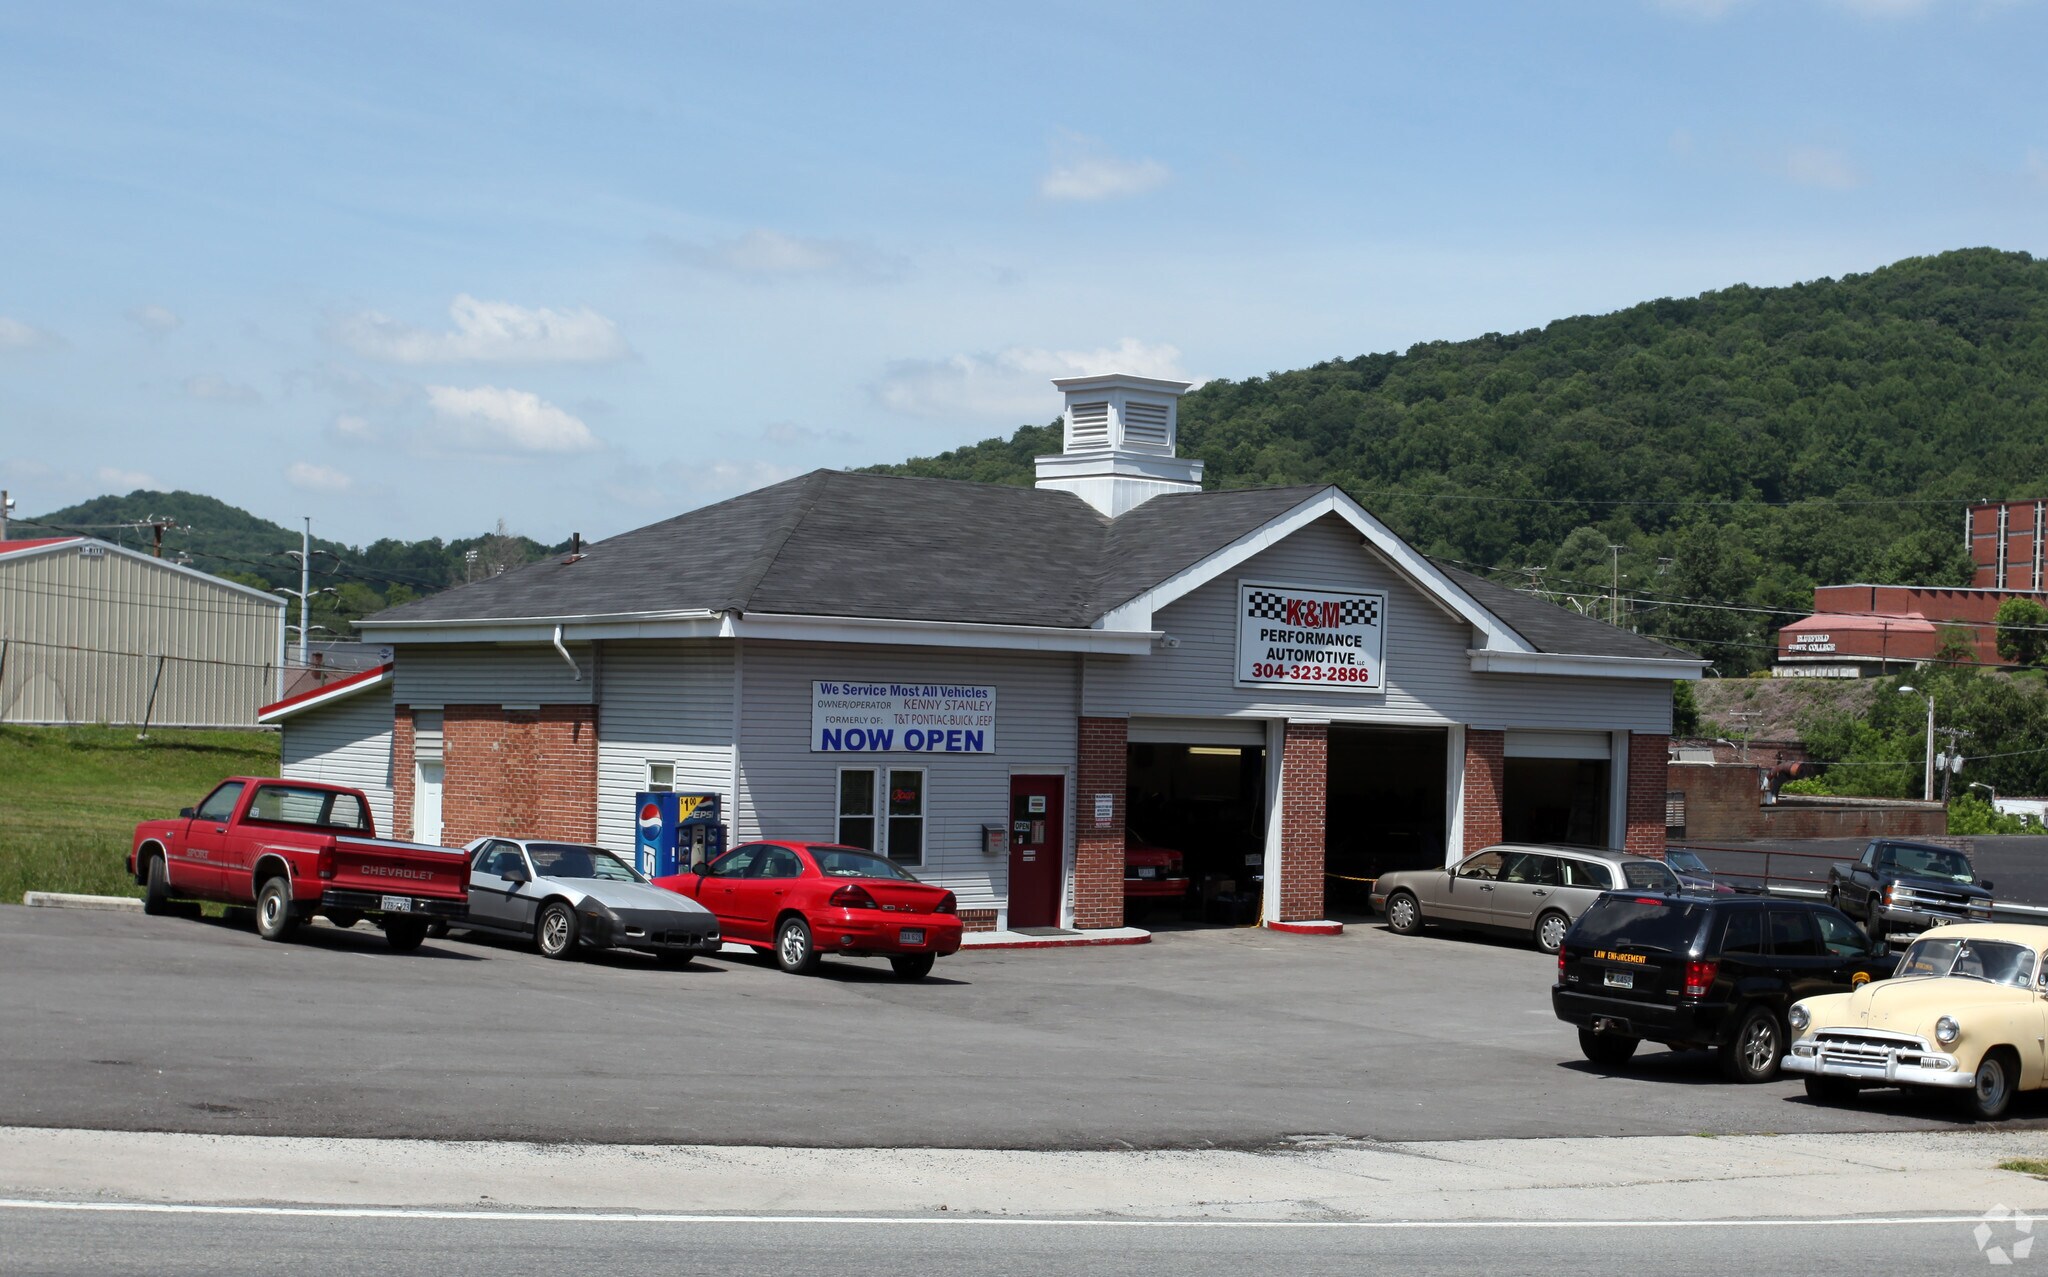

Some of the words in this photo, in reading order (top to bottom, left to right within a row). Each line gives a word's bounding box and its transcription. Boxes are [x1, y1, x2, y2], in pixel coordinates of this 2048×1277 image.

[1286, 598, 1340, 628] K&M
[1260, 629, 1362, 647] PERFORMANCE
[1796, 634, 1829, 643] BLUEFIELD
[1788, 644, 1807, 652] STATE
[1808, 643, 1836, 652] COLLEGE
[1266, 648, 1355, 665] AUTOMOTIVE
[1252, 663, 1369, 682] 304-323-2886
[820, 683, 839, 695] We
[842, 683, 887, 696] Service
[890, 684, 920, 697] Most
[922, 686, 938, 698] All
[940, 686, 988, 698] Vehicles
[817, 700, 892, 709] OWNER/OPERATOR
[903, 699, 943, 710] KENNY
[944, 700, 993, 711] STANLEY
[825, 716, 869, 724] FORMERLY
[870, 716, 883, 724] OF:
[894, 714, 909, 725] T&T
[911, 714, 974, 726] PONTIAC-BUICK
[975, 715, 993, 726] JEEP
[821, 728, 894, 751] NOW
[904, 729, 984, 752] OPEN
[687, 811, 714, 819] PEPSI
[1015, 822, 1030, 830] OPEN
[186, 848, 209, 859] SPORT
[361, 865, 434, 880] CHEVROLET
[1594, 950, 1606, 959] LAW
[1607, 952, 1647, 964] ENFORCEMENT
